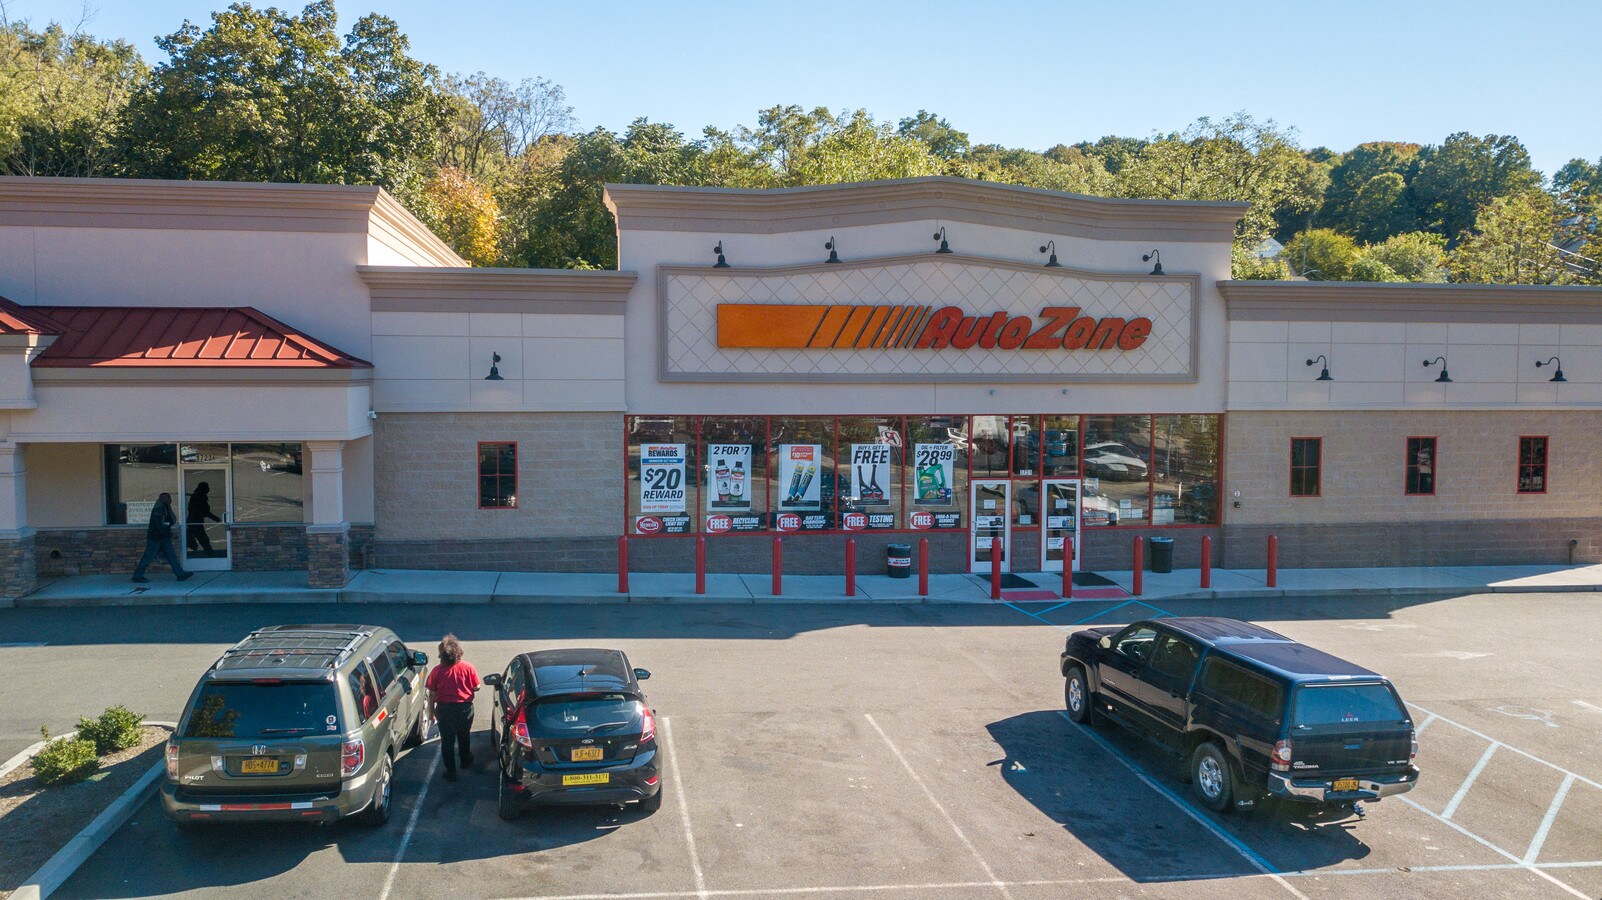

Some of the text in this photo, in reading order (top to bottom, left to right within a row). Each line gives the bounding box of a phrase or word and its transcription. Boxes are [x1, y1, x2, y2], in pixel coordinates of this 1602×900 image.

[914, 306, 1153, 350] AutoZone
[713, 446, 750, 455] 2 FOR $7
[853, 450, 888, 464] FREE
[644, 468, 681, 490] $20
[643, 490, 683, 499] REWARD
[710, 518, 729, 529] FREE
[780, 517, 799, 528] FREE
[846, 516, 865, 527] FREE
[869, 514, 894, 523] TESTING
[914, 515, 931, 525] FREE
